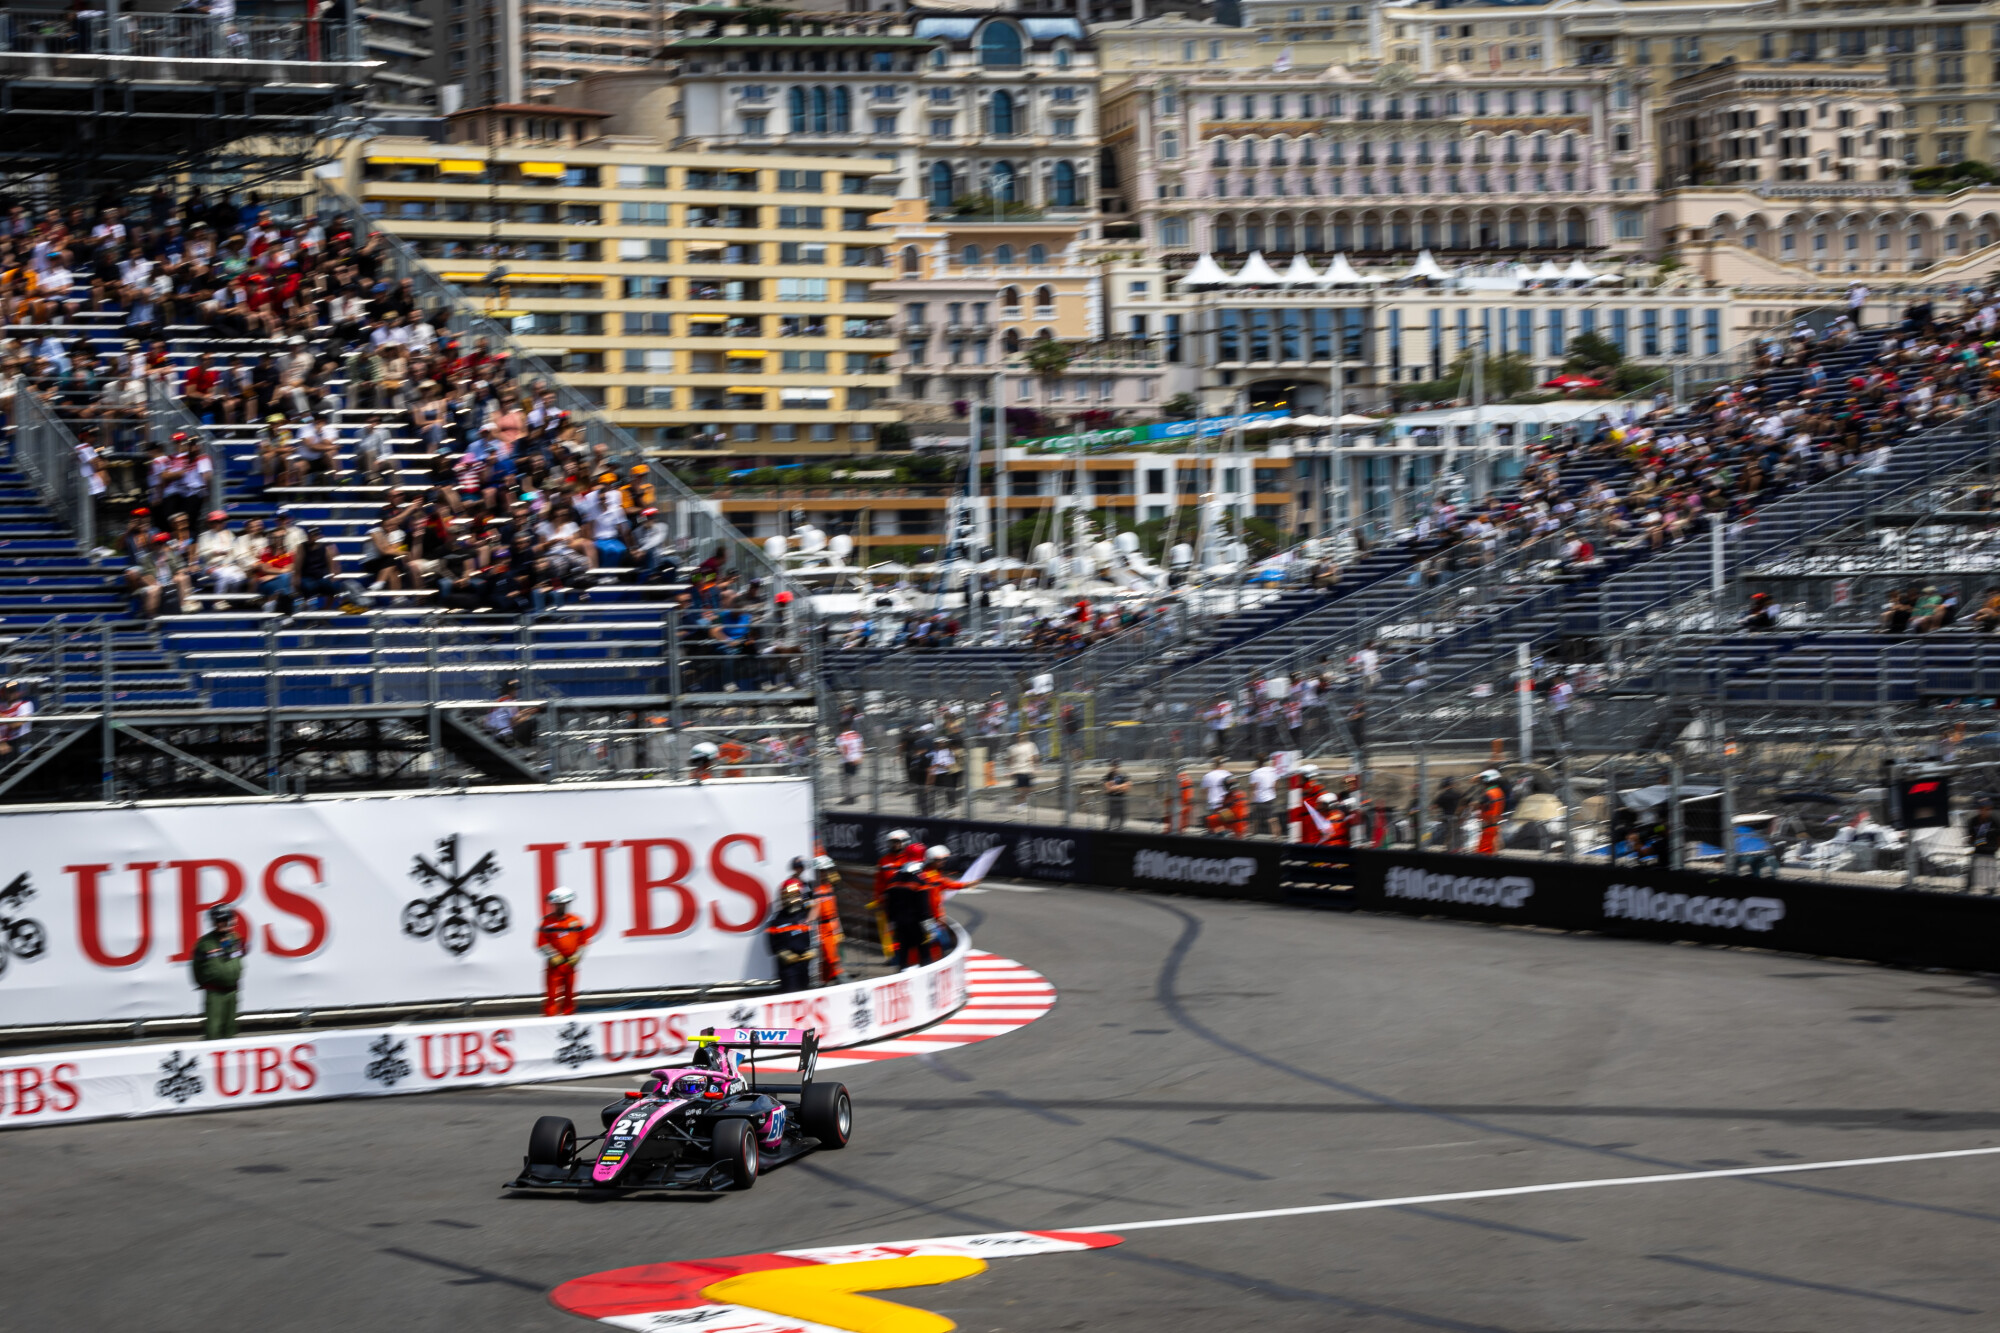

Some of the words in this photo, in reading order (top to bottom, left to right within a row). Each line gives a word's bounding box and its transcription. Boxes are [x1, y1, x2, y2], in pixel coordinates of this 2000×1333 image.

[61, 853, 329, 967] UBS
[526, 833, 769, 940] UBS
[417, 1028, 515, 1079] UBS
[601, 1013, 689, 1063] UBS
[209, 1043, 317, 1097] UBS
[612, 1119, 646, 1136] 21
